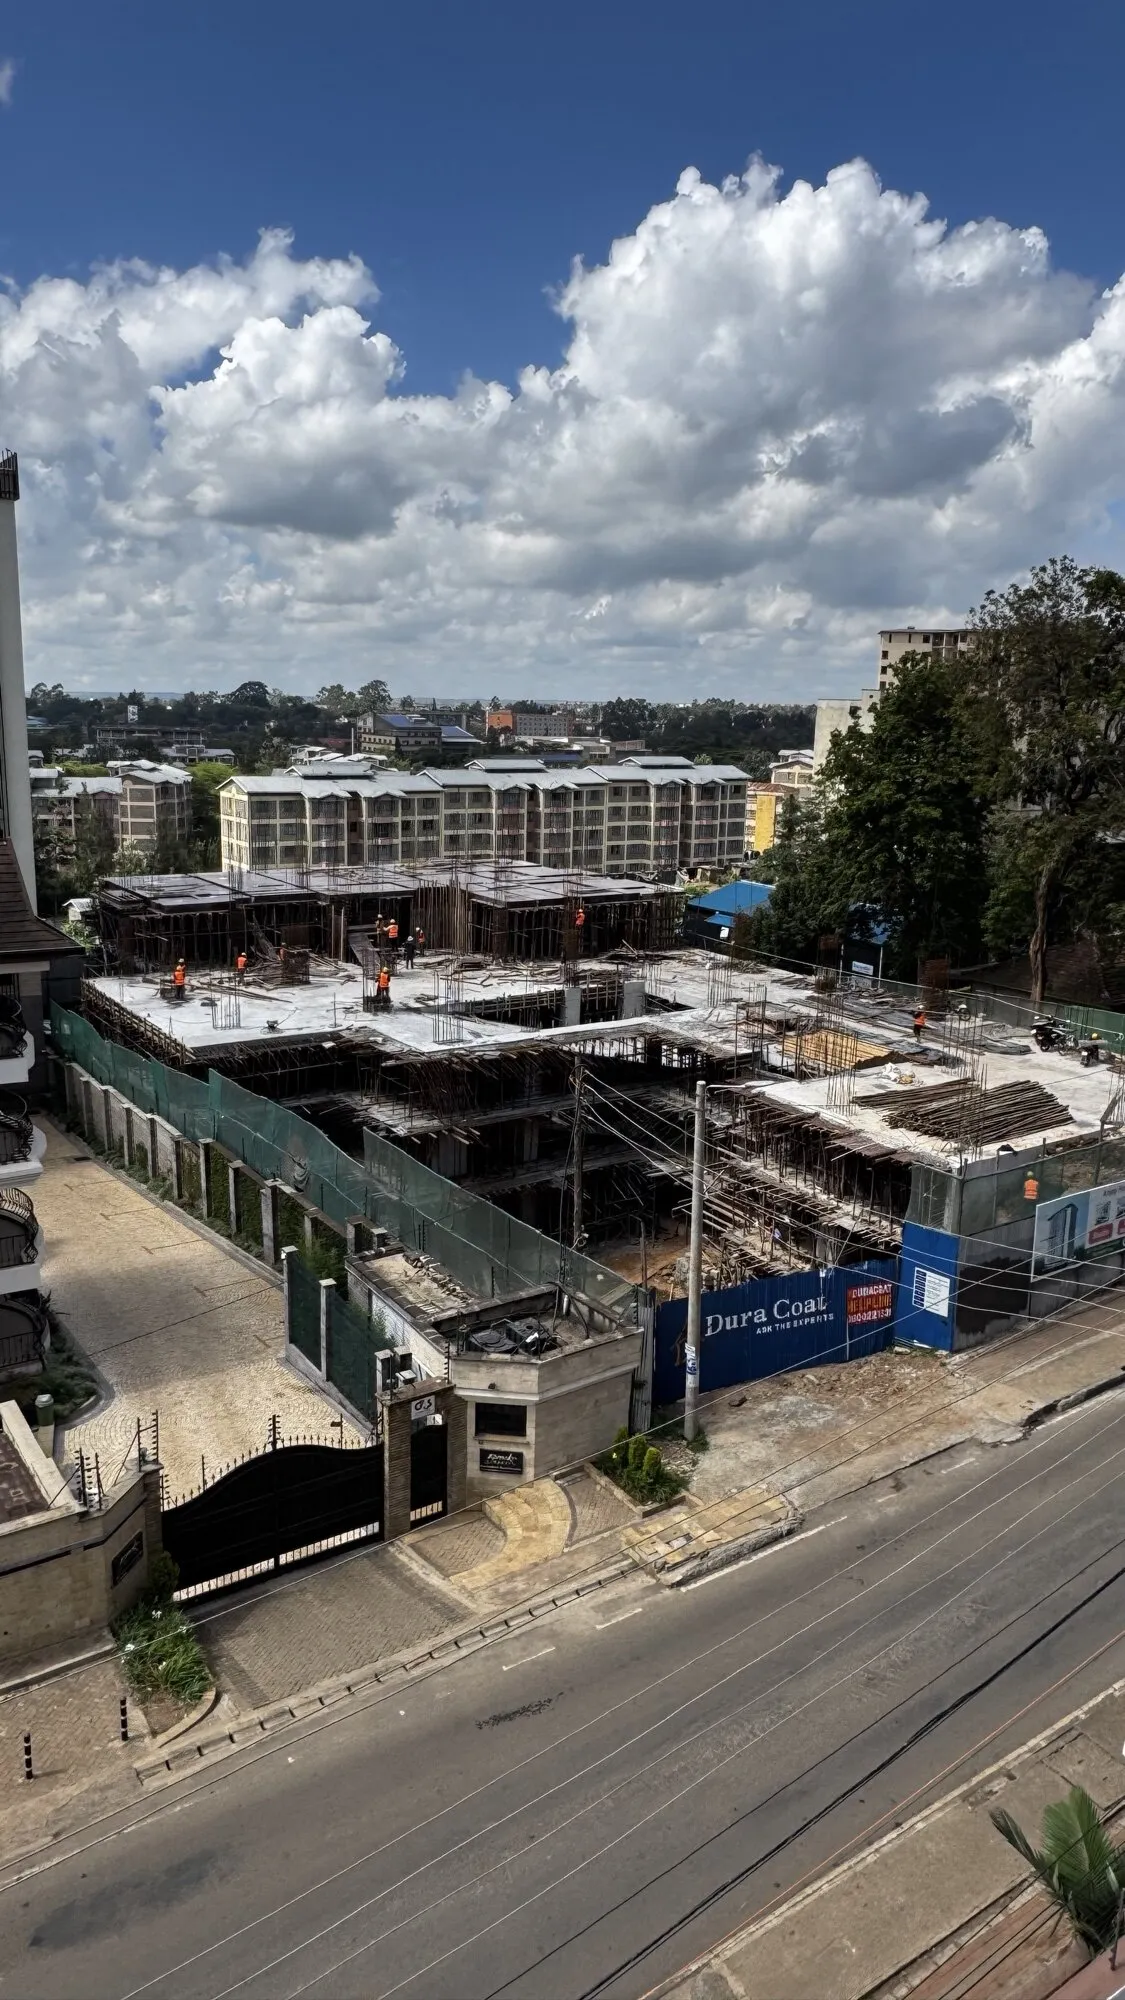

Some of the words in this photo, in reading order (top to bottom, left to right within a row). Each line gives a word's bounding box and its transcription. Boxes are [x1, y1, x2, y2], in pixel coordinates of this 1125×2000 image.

[705, 1308, 767, 1337] Dura
[773, 1296, 828, 1319] Coat
[756, 1325, 772, 1335] ASK
[775, 1321, 791, 1330] THE
[793, 1313, 834, 1328] EXPERTS
